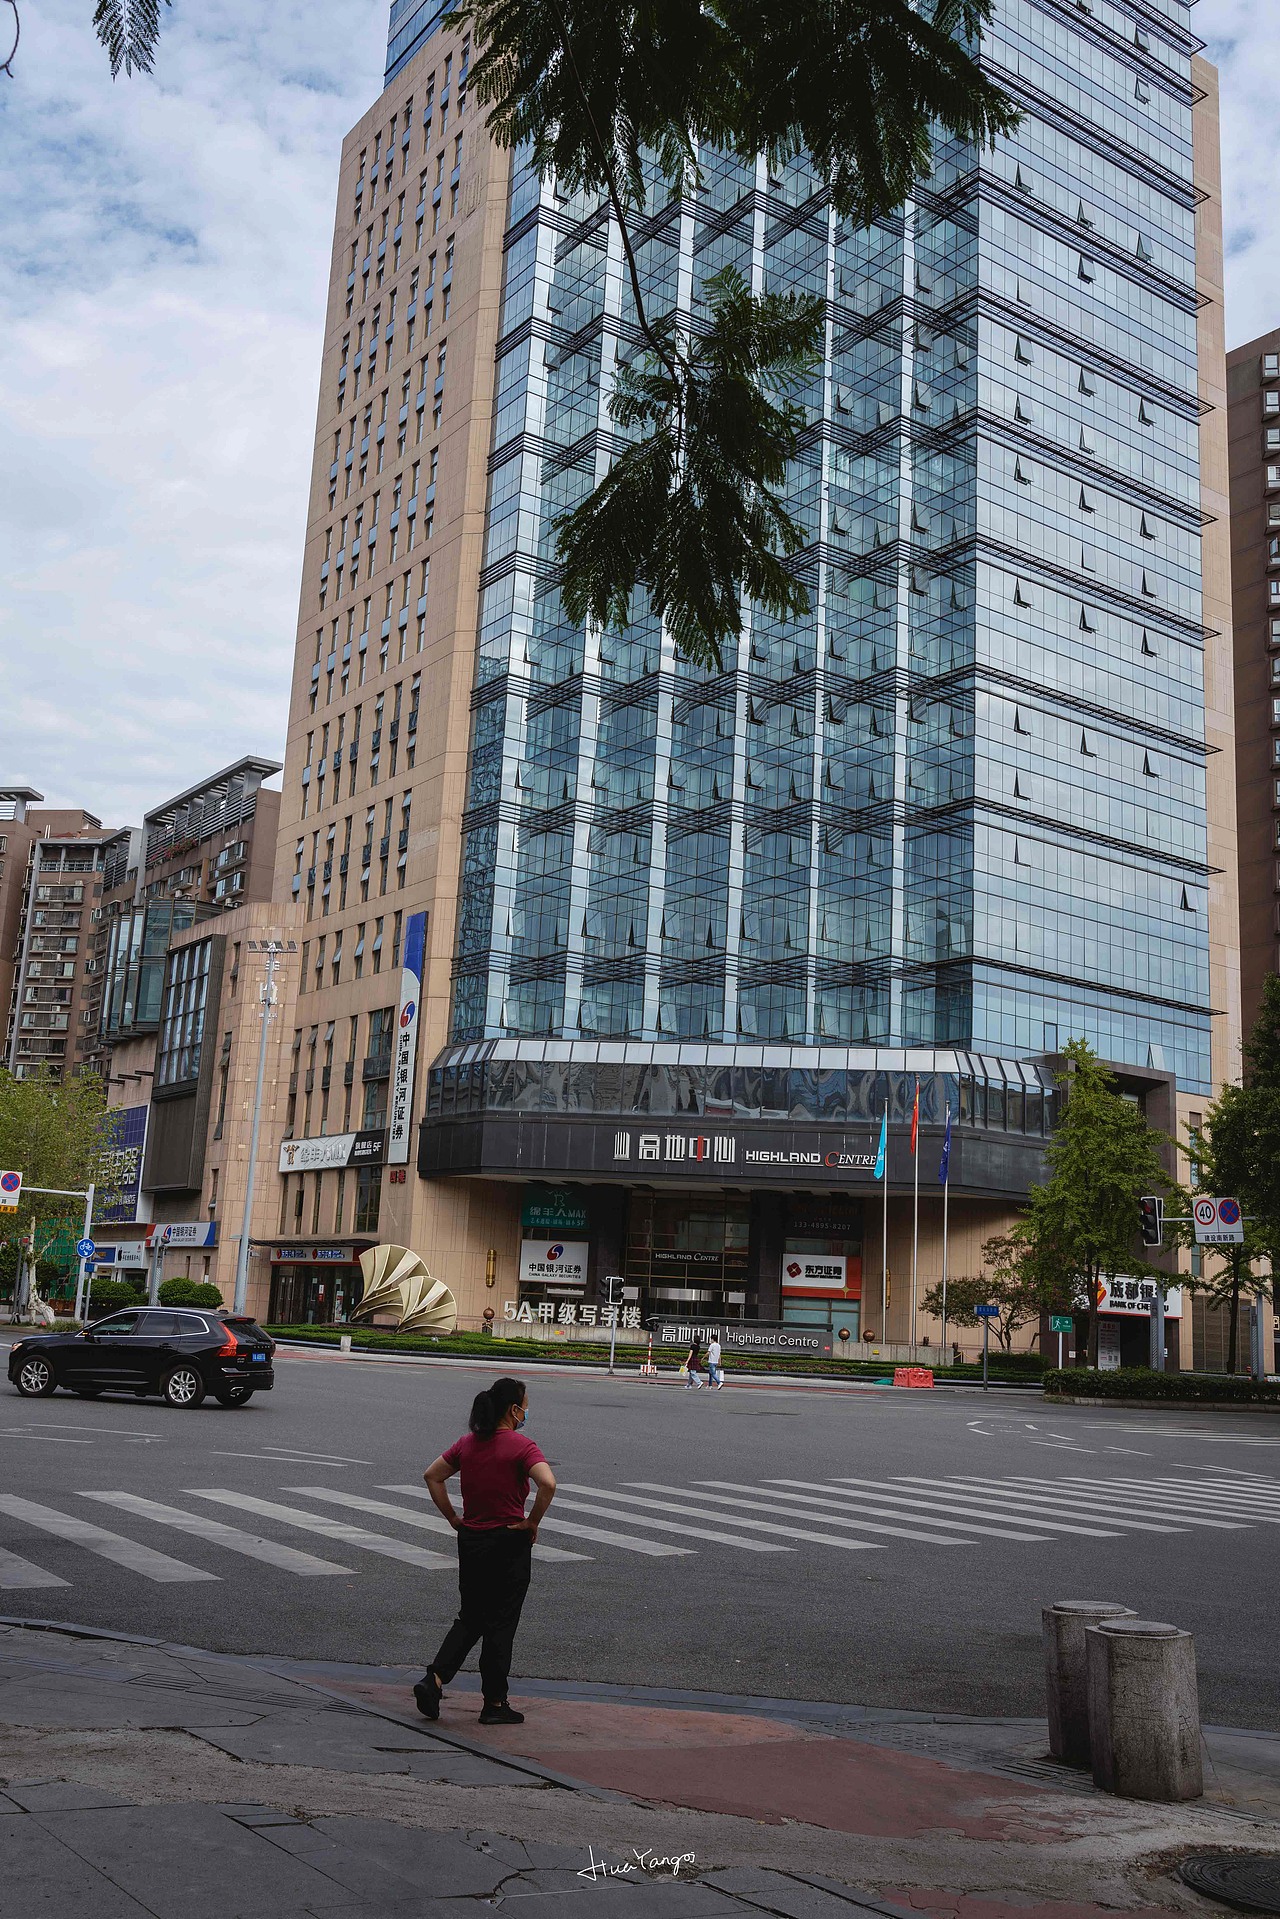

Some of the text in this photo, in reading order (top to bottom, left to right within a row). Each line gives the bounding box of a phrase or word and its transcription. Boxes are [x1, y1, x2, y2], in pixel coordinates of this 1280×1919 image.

[638, 1135, 736, 1163] 高地中心
[746, 1151, 876, 1167] HIGHLAND CENTRE
[1200, 1205, 1212, 1219] 40
[655, 1253, 691, 1261] HIGHLAND
[529, 1263, 581, 1274] 中国银河证券
[1110, 1300, 1127, 1309] BANK
[504, 1301, 641, 1330] 5A甲级写字楼
[727, 1332, 819, 1348] Highland Centre
